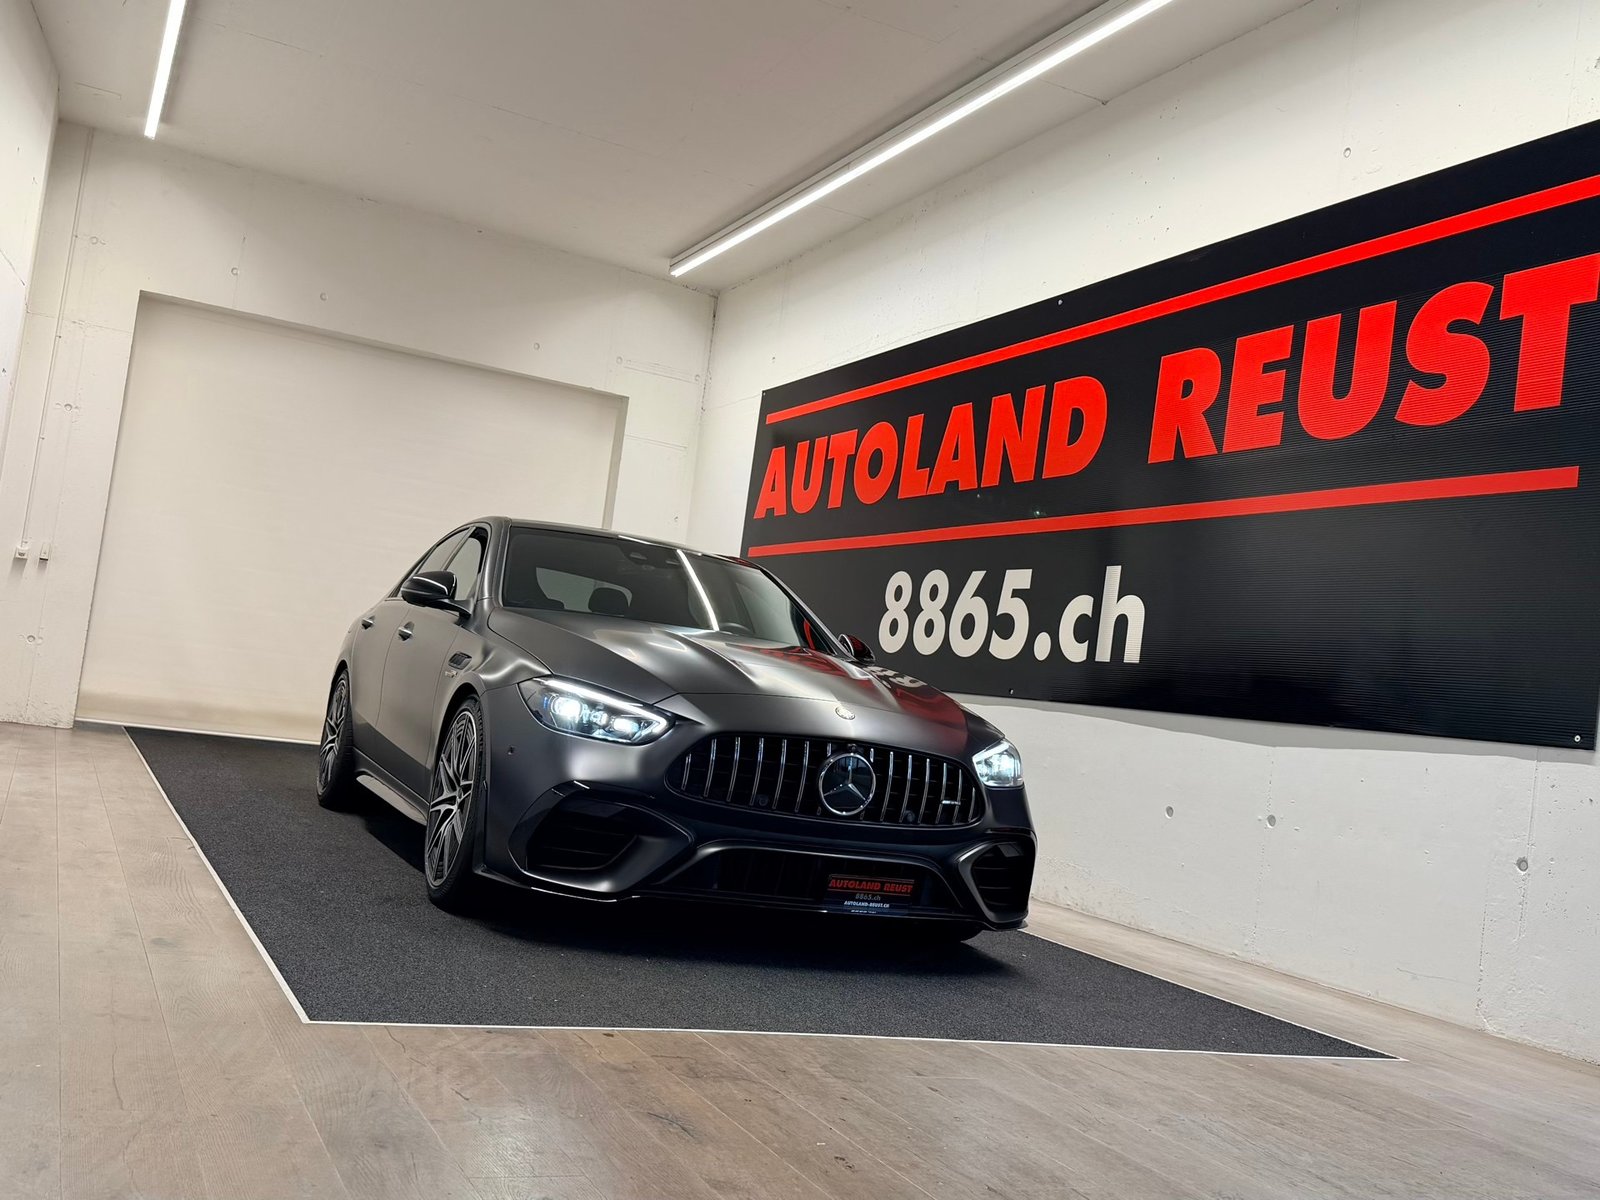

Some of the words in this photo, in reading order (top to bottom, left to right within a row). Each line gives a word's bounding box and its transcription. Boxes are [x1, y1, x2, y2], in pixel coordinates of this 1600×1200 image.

[753, 375, 1108, 520] AUTOLAND
[1148, 252, 1600, 464] REUST
[878, 565, 1146, 664] 8865.ch
[829, 879, 881, 890] AUTOLAND
[884, 883, 913, 893] REUST
[844, 900, 890, 908] AUTOLAND-REUST.CH
[855, 893, 881, 901] 8865.ch
